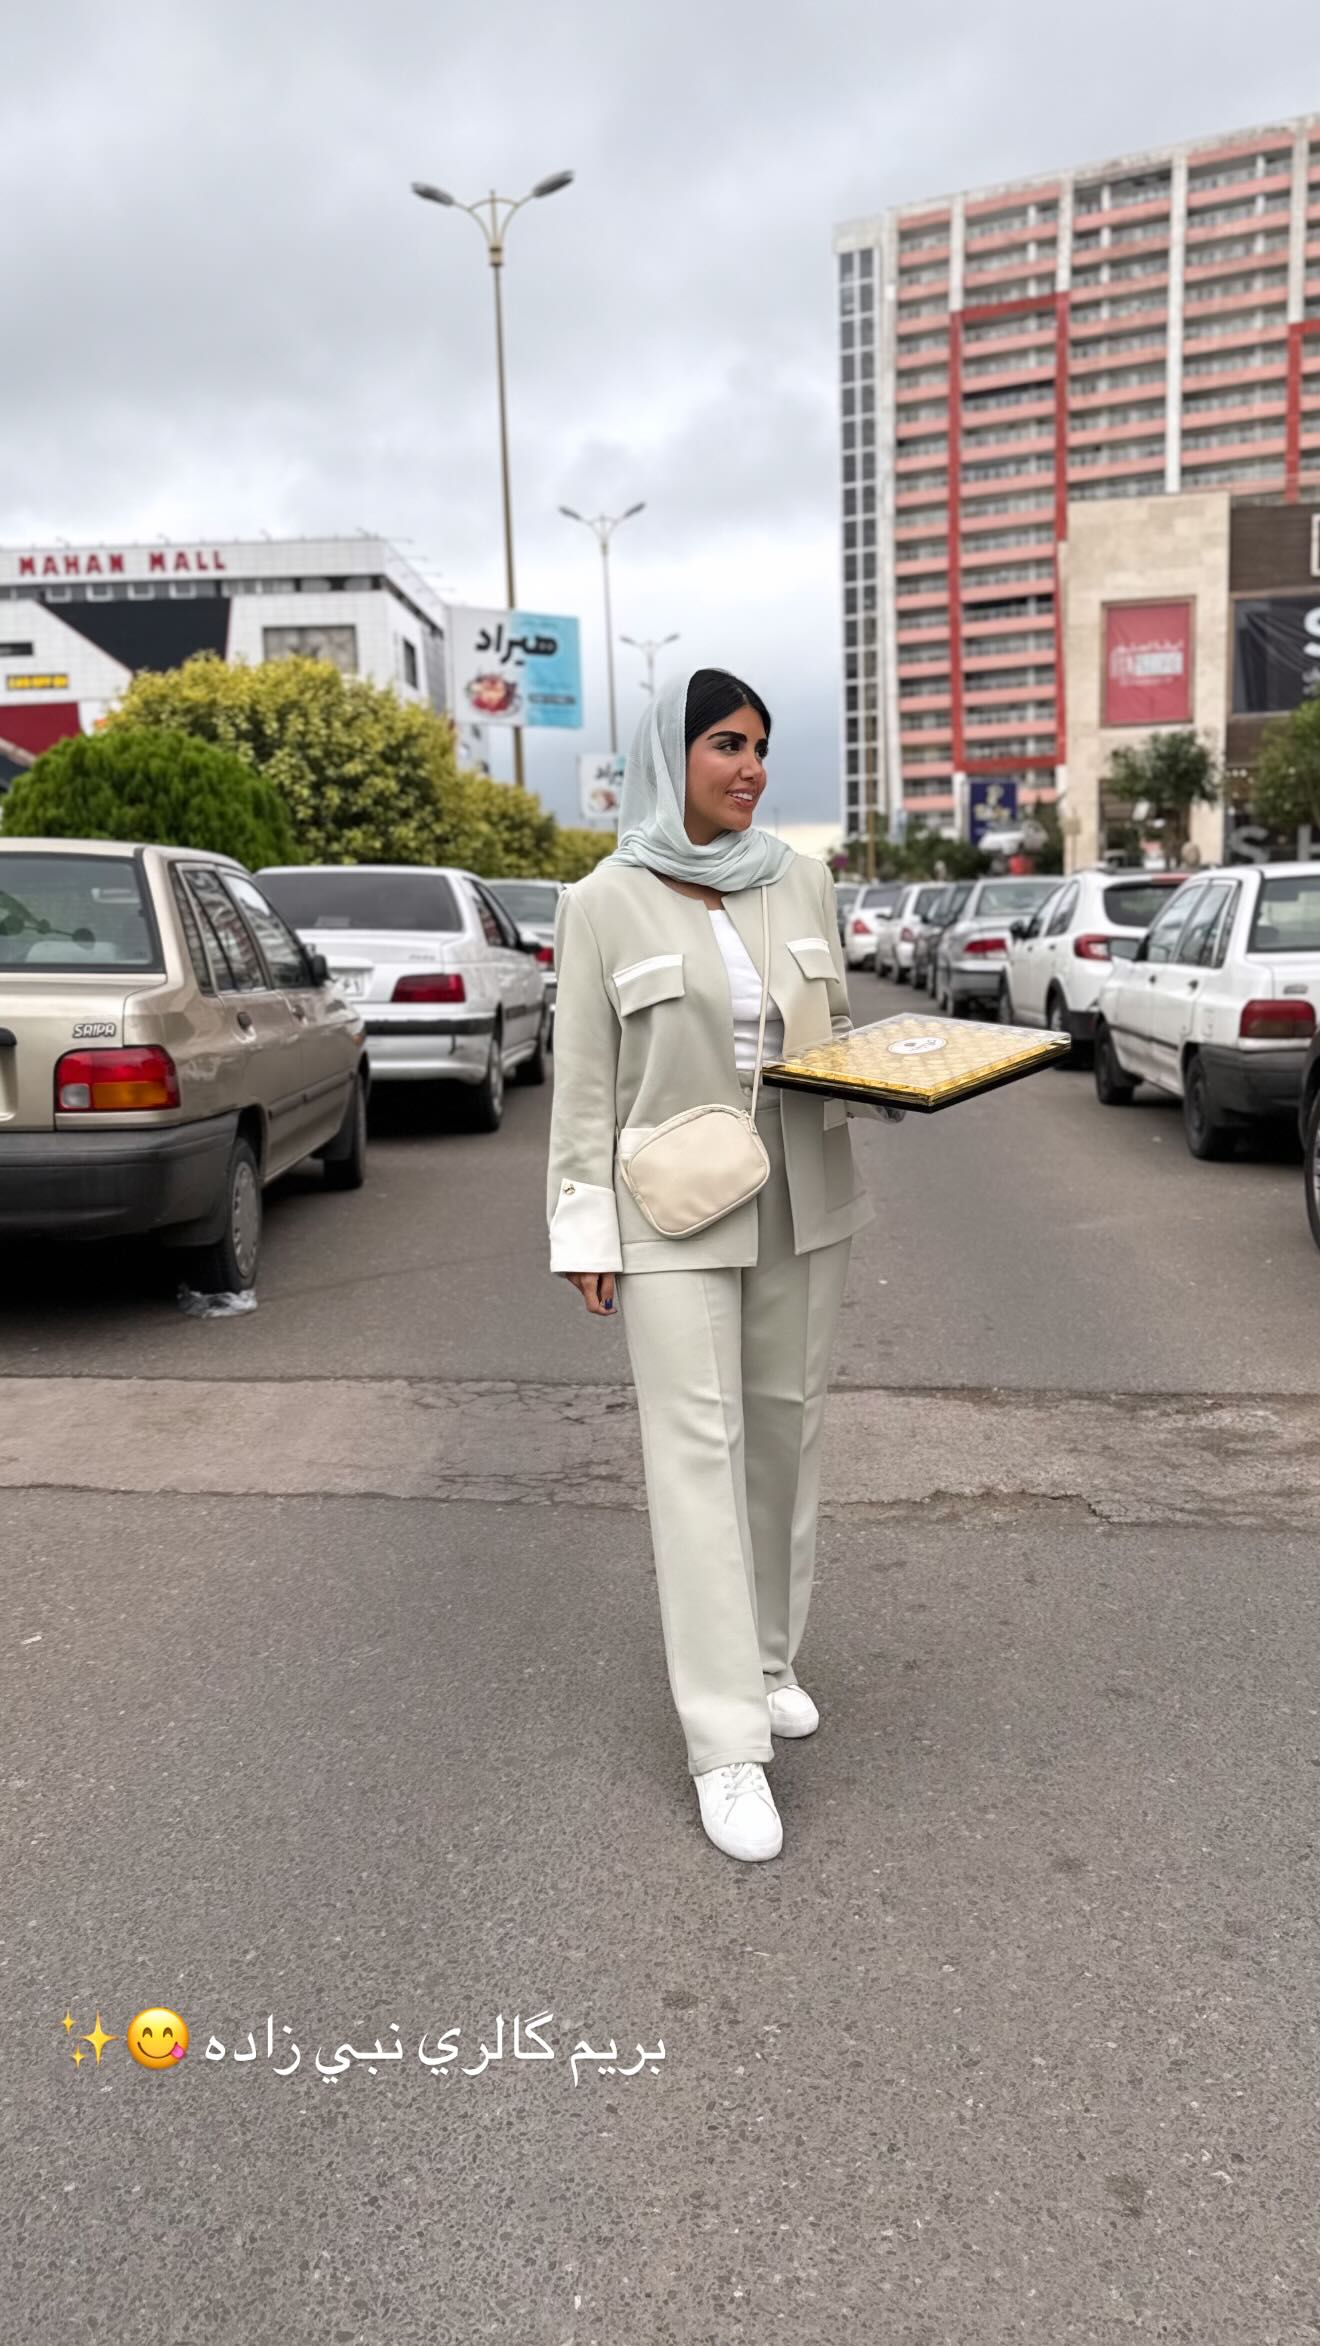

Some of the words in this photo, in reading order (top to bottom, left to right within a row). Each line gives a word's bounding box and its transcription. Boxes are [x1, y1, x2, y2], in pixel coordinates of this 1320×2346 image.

[18, 552, 125, 577] MAHAN
[149, 548, 228, 573] MALL
[475, 622, 558, 666] هیراد
[72, 1022, 117, 1039] SAIPA
